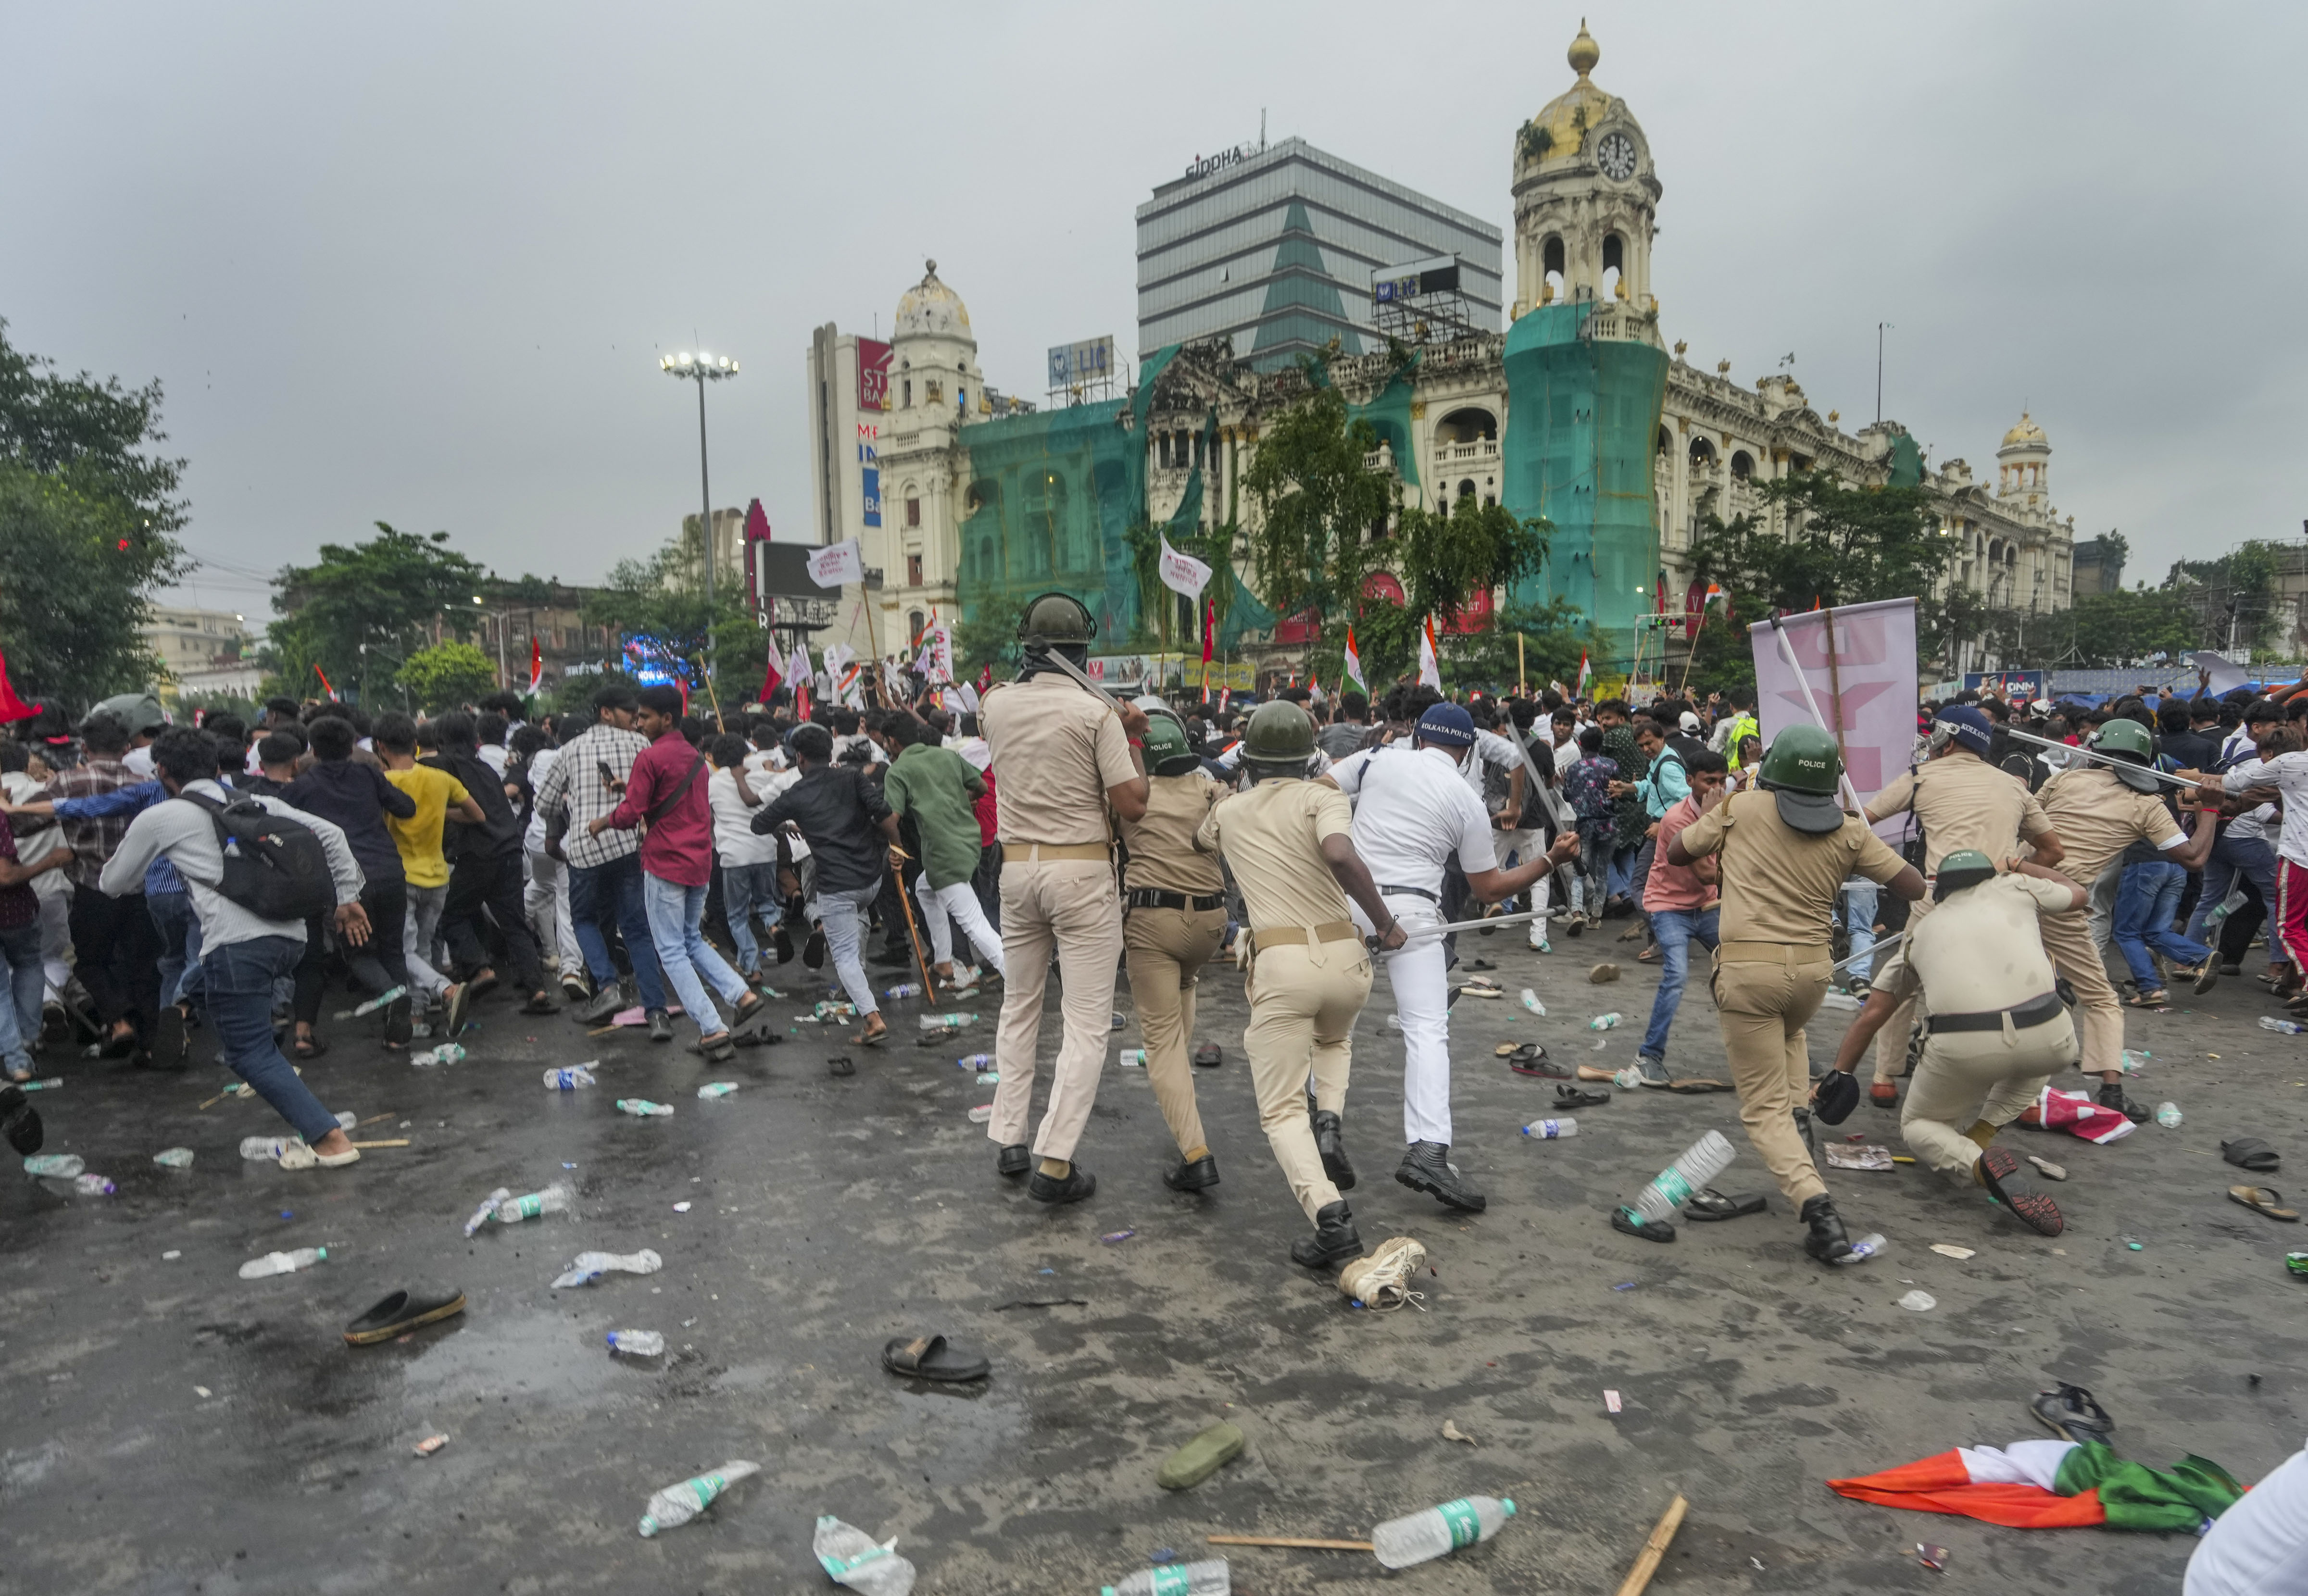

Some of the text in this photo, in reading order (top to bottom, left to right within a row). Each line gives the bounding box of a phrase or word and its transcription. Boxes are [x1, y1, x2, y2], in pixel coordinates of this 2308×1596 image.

[1186, 146, 1241, 180] SIDDHA
[1079, 346, 1105, 372] LIC
[1692, 596, 1699, 612] V
[1421, 722, 1449, 734] KOLKATA
[2135, 729, 2151, 740] POLICE
[1150, 742, 1172, 752] POLICE
[1798, 759, 1826, 769] POLICE
[1948, 852, 1972, 860] POLICE
